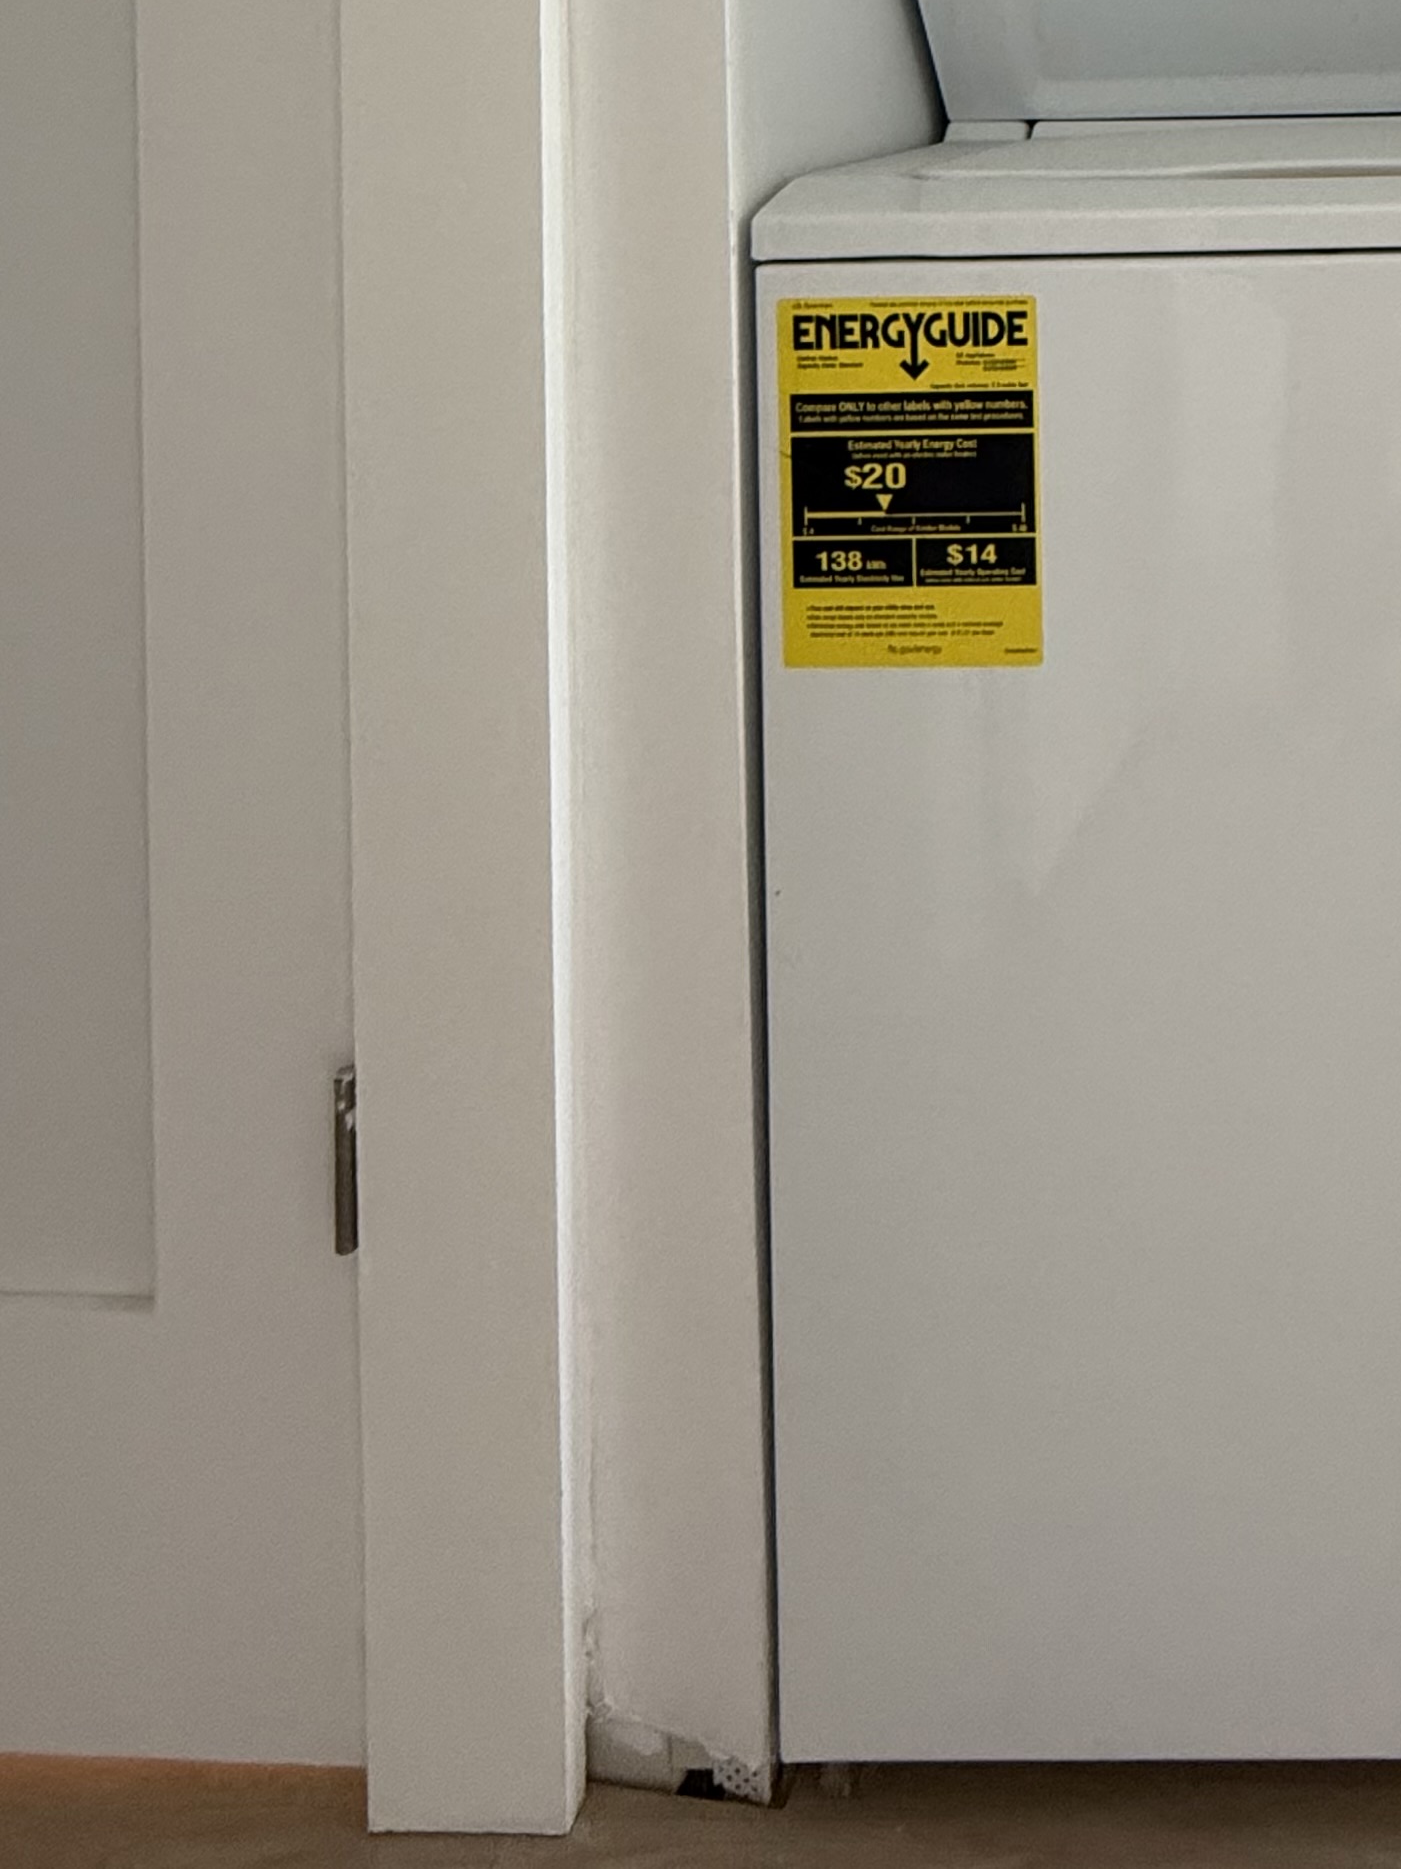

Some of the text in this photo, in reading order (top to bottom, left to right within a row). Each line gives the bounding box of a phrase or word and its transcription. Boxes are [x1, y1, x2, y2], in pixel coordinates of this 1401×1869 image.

[792, 310, 1028, 353] ENERGYGUIDE
[795, 401, 837, 414] Compare
[838, 400, 866, 412] ONLY
[866, 401, 877, 412] to
[877, 399, 902, 412] other
[903, 398, 932, 411] labels
[933, 398, 953, 410] with
[953, 397, 984, 412] yellow
[848, 437, 978, 452] Estimated Yearly Energy Cost
[844, 462, 907, 490] $20
[815, 550, 863, 572] 138
[946, 543, 998, 566] $14
